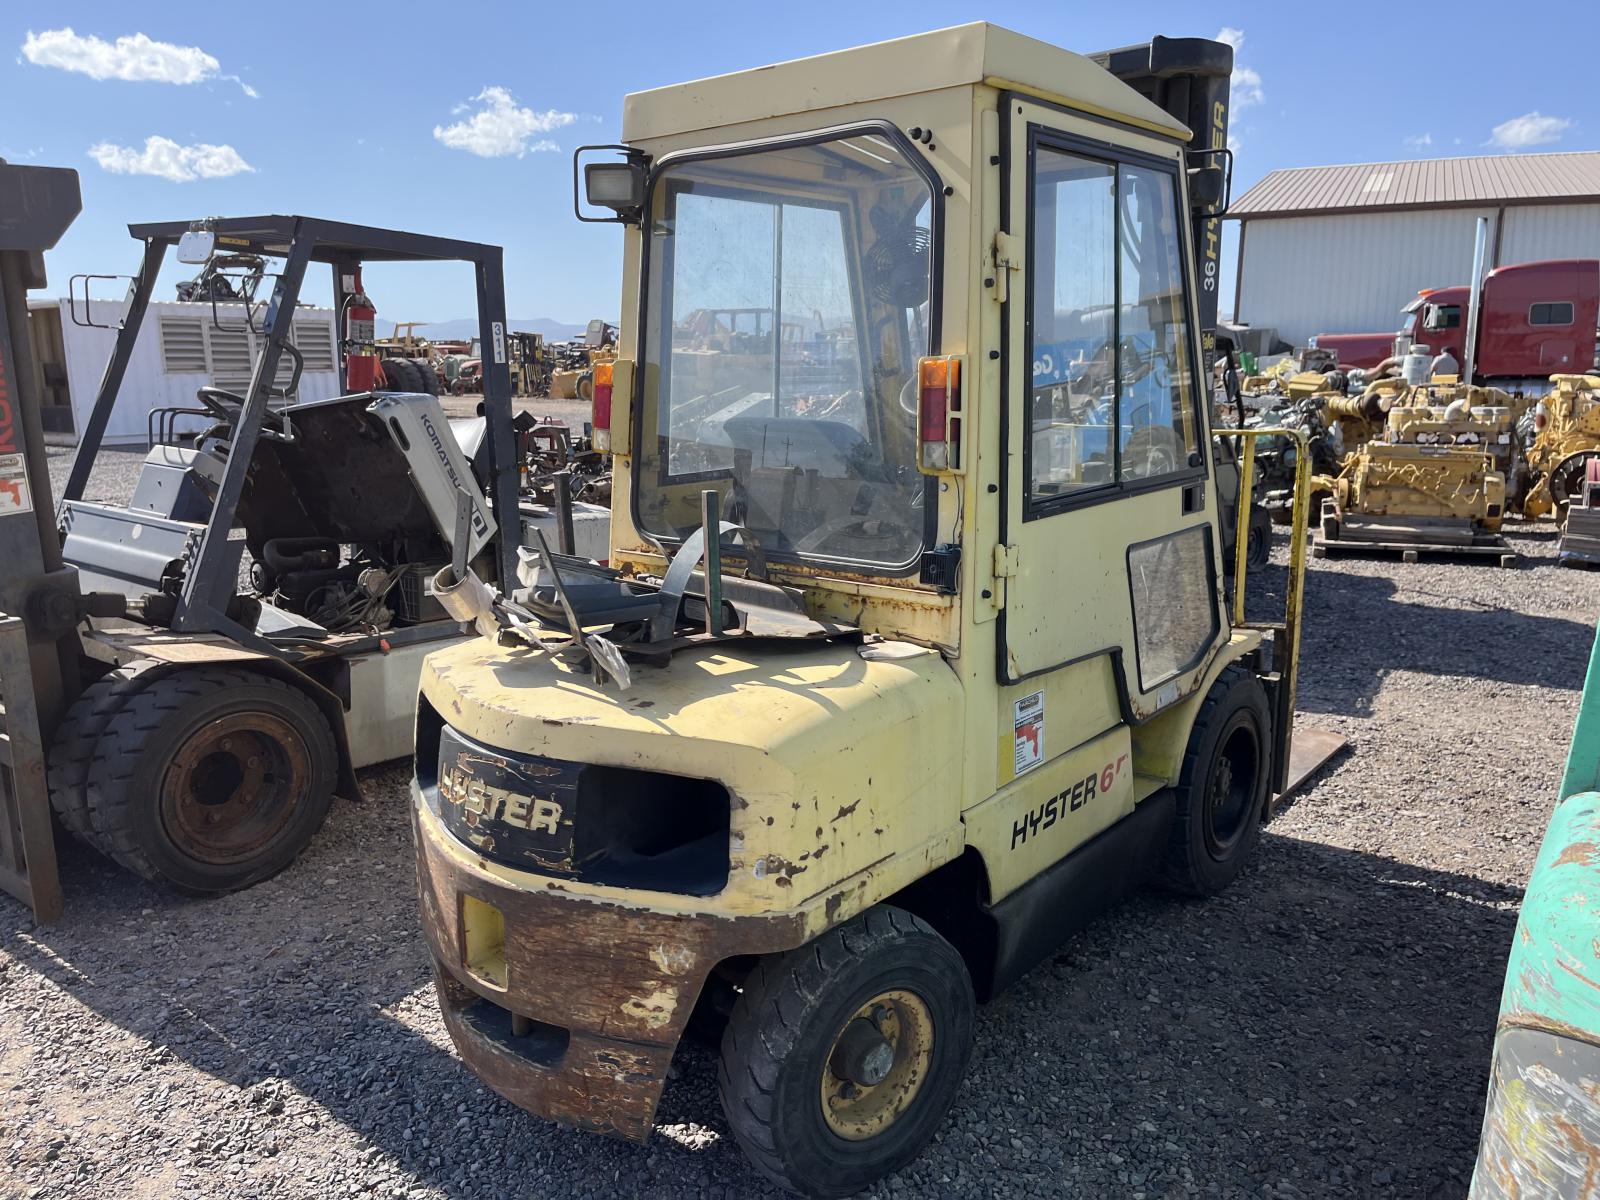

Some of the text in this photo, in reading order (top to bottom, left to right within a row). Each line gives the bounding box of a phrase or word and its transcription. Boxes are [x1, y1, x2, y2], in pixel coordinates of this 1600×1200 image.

[1204, 261, 1216, 292] 36
[494, 323, 502, 362] 311
[420, 413, 461, 489] KOMATSU
[1011, 772, 1098, 851] HYSTER
